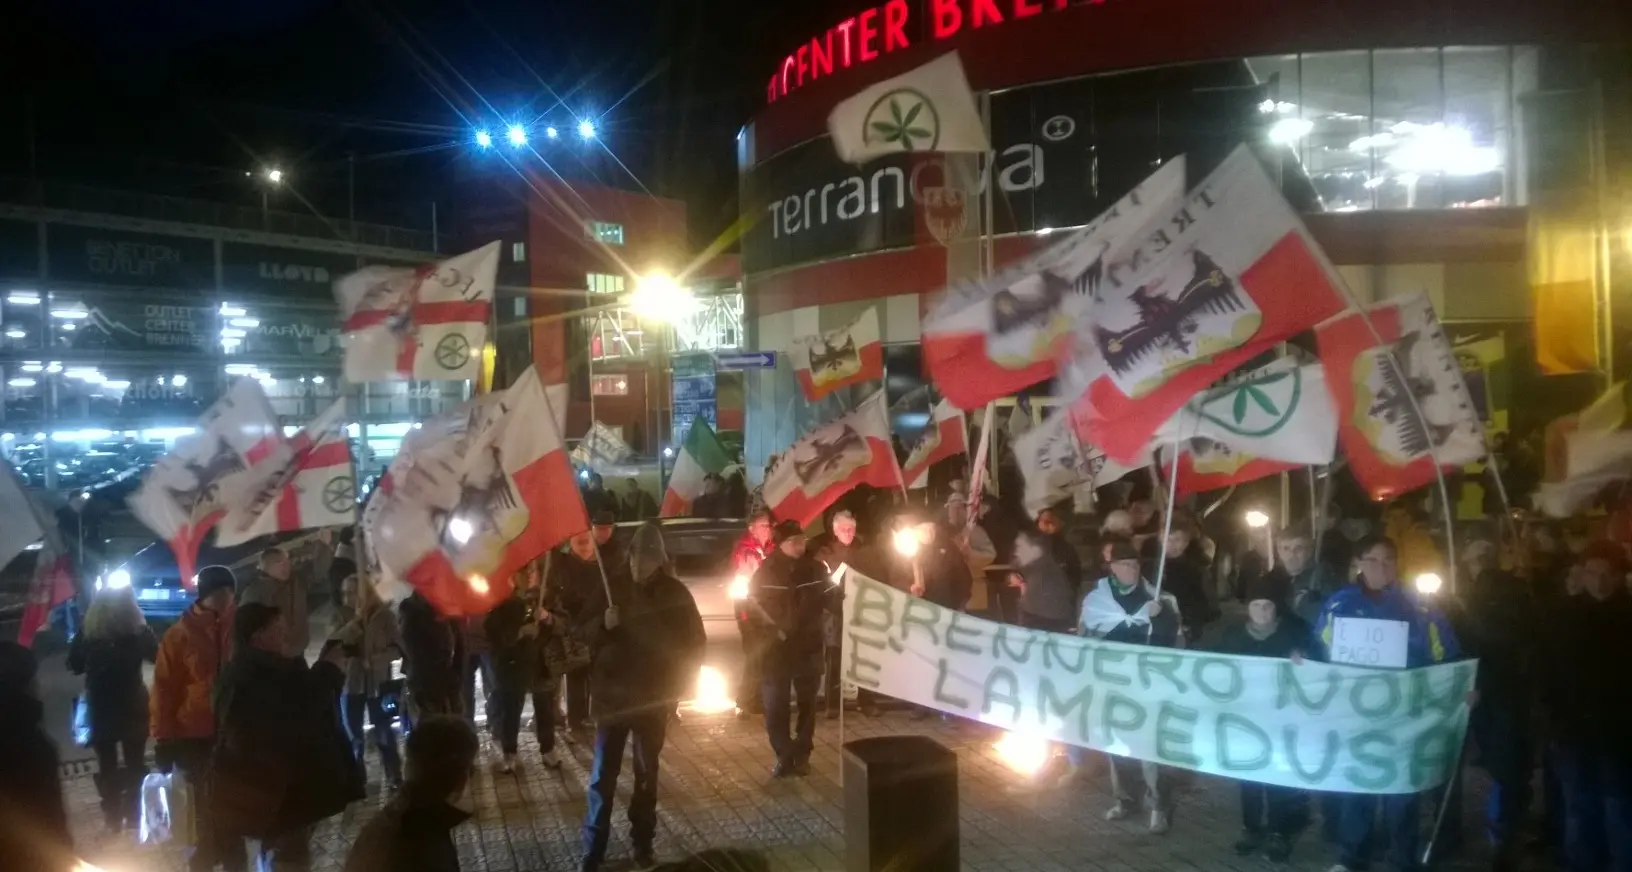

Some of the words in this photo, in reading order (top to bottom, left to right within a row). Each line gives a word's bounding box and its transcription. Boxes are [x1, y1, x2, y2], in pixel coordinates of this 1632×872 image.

[258, 262, 329, 283] LLOYD
[848, 576, 1243, 704] BRENNERO
[1273, 661, 1469, 720] NON
[932, 656, 1466, 791] LAMPEDUSA
